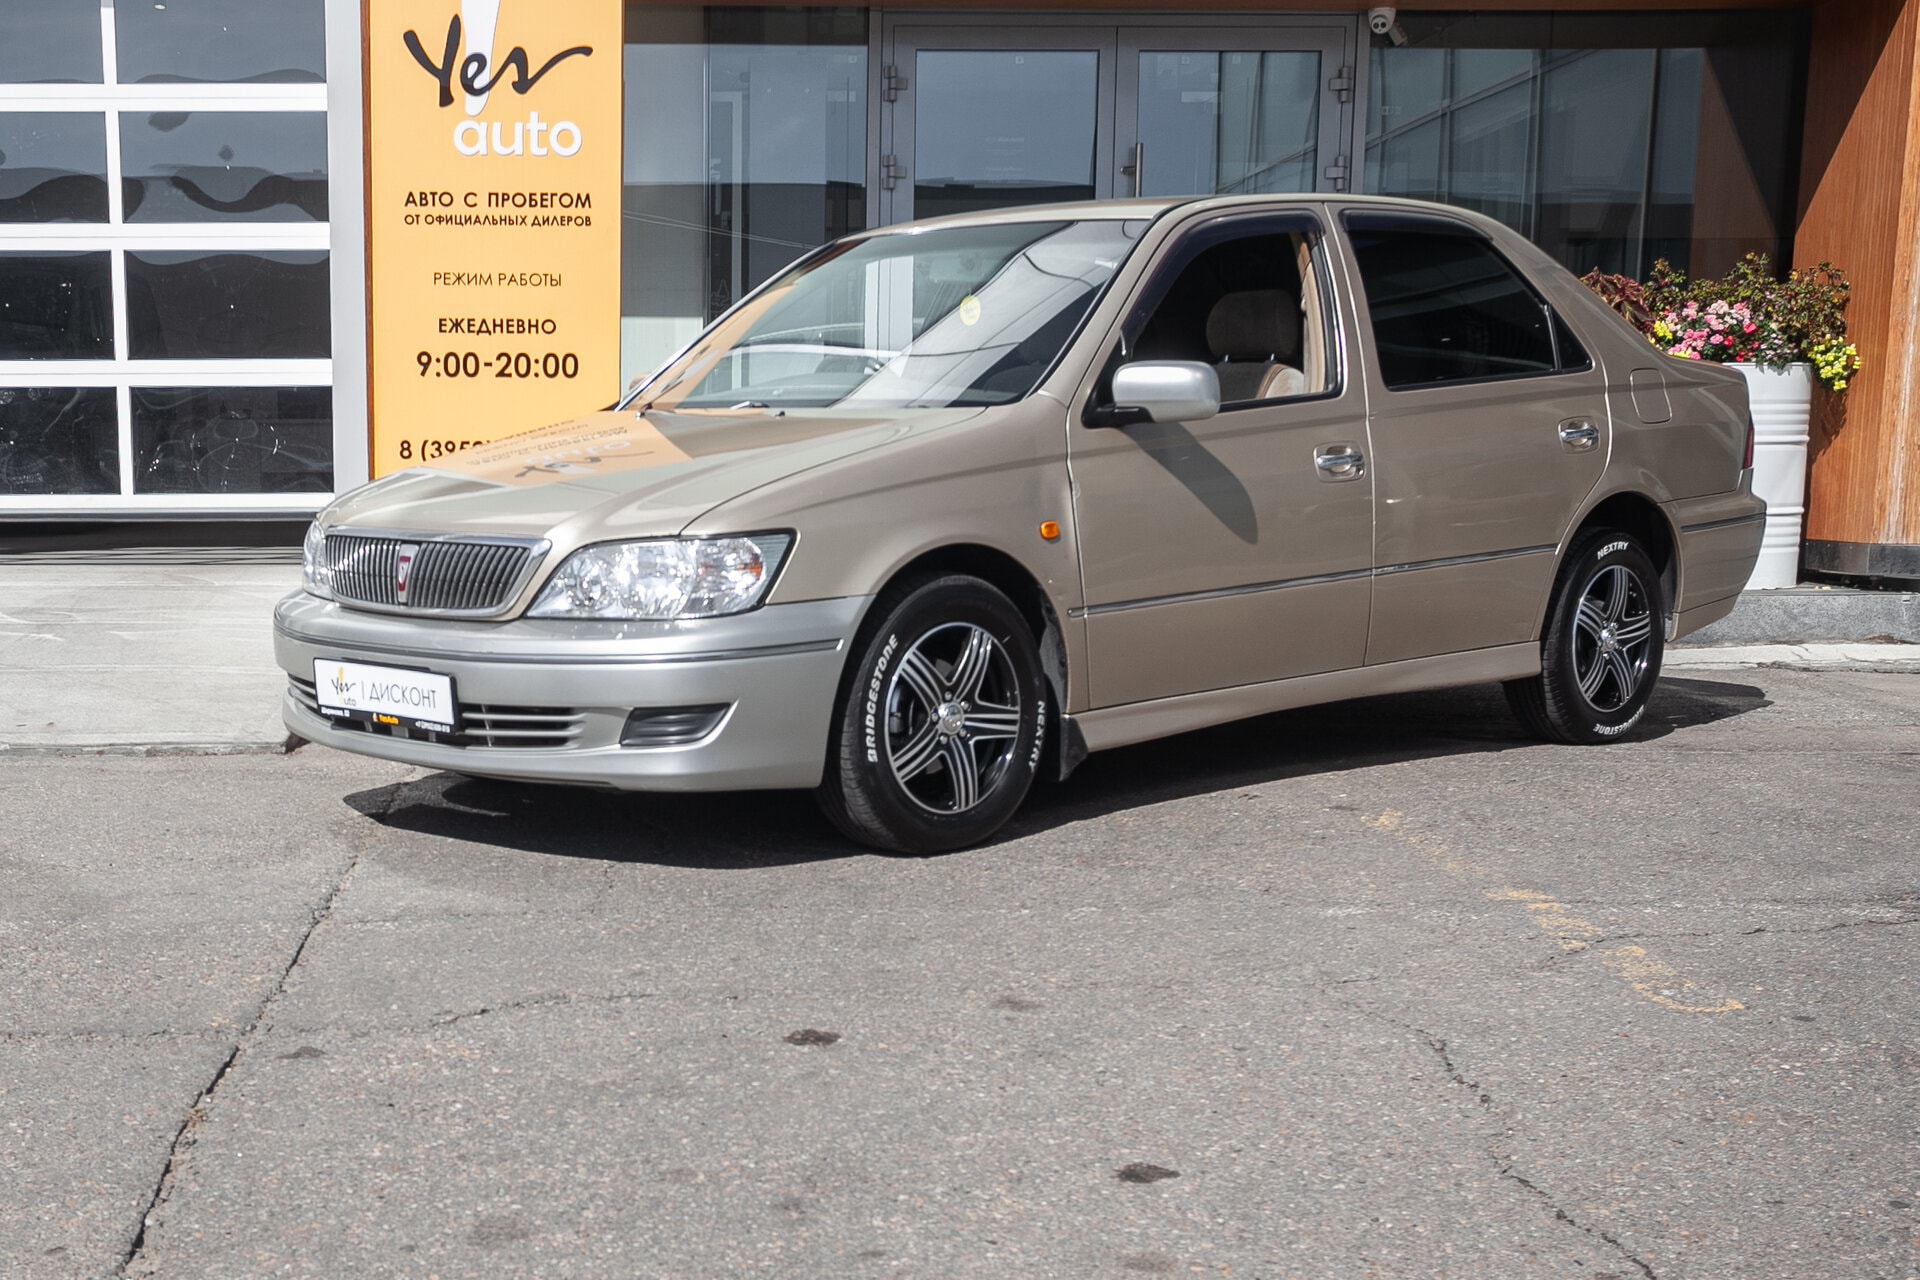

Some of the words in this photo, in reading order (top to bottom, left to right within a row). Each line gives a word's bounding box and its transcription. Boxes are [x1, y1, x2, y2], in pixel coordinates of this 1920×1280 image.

[403, 14, 593, 108] Yes
[453, 110, 583, 157] auto
[404, 191, 454, 208] АВТО
[463, 192, 478, 208] С
[488, 192, 592, 209] ПРОБЕГОМ
[404, 214, 420, 226] ОТ
[424, 214, 528, 228] ОФИЦИАЛЬНЫХ
[531, 215, 592, 228] ДИЛЕРОВ
[433, 272, 493, 286] РЕЖИМ
[499, 273, 562, 287] РАБОТЫ
[438, 318, 557, 336] ЕЖЕДНЕВНО
[416, 351, 579, 379] 9:00-20:00
[399, 440, 412, 459] 8
[1597, 541, 1629, 560] NEXTRY
[369, 682, 437, 709] ДИСКОНТ
[864, 634, 898, 763] BRIDGESTONE
[1028, 700, 1045, 773] NEXTRY
